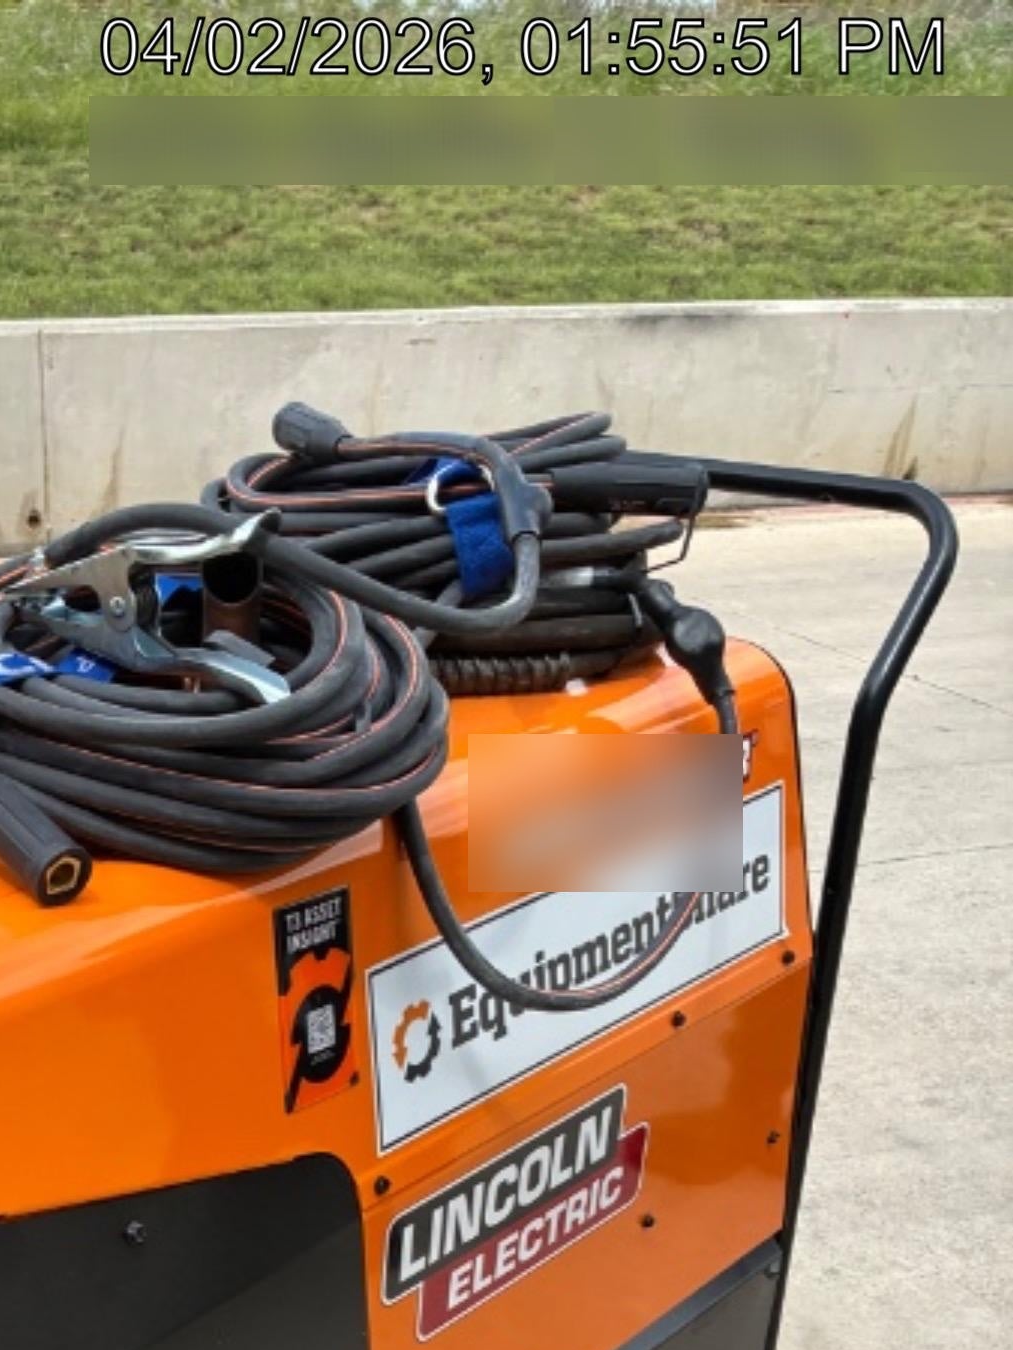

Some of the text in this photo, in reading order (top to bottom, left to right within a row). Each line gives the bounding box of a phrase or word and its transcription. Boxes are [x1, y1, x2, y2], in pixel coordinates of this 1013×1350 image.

[287, 921, 338, 954] INSIGHT
[305, 898, 342, 923] ASSET
[449, 854, 770, 1048] Eqipmenthare
[399, 1106, 613, 1283] LINCOLN
[446, 1166, 624, 1311] ELECTRIC
